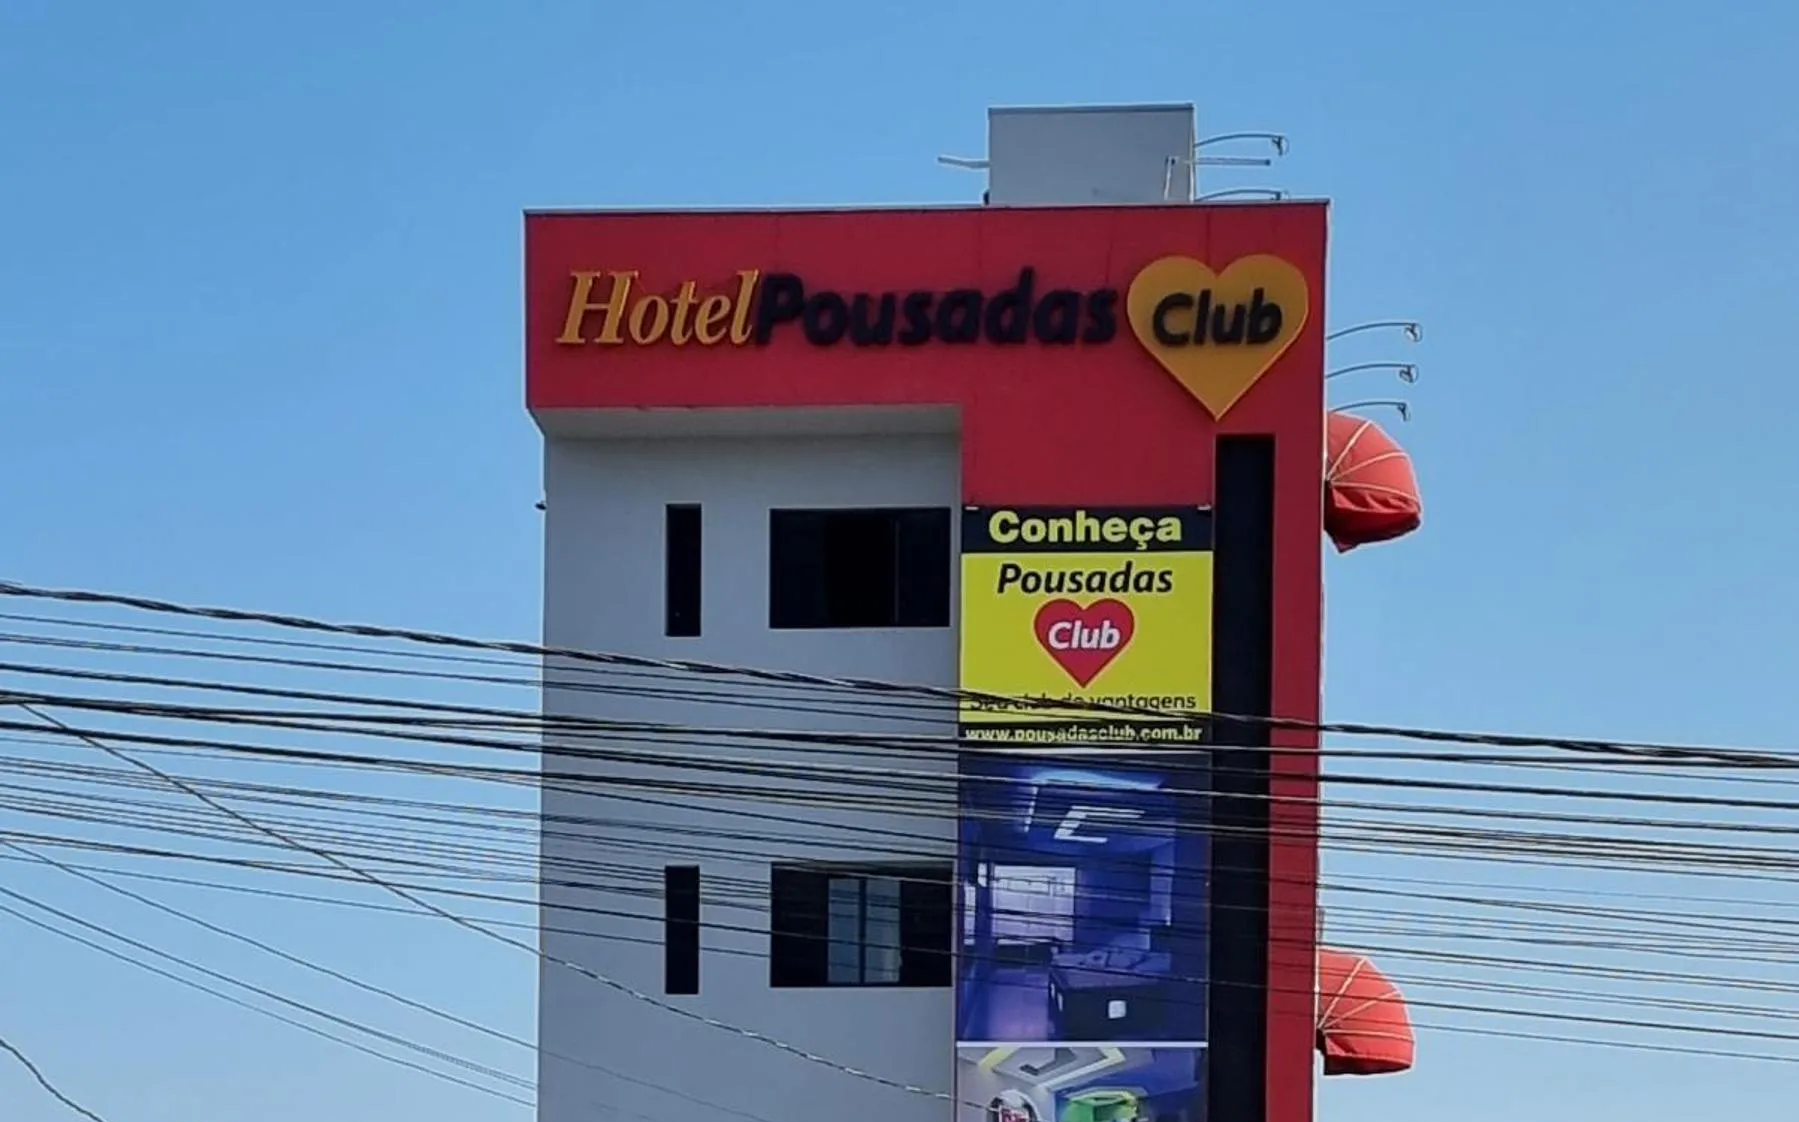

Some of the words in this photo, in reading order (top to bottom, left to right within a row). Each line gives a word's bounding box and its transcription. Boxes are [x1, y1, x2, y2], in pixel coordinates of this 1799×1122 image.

[555, 268, 760, 346] Hotel
[755, 265, 1120, 347] Pousadas
[1151, 287, 1283, 347] Club
[988, 510, 1182, 550] Conheça
[997, 561, 1174, 594] Pousadas
[1047, 620, 1122, 650] Club
